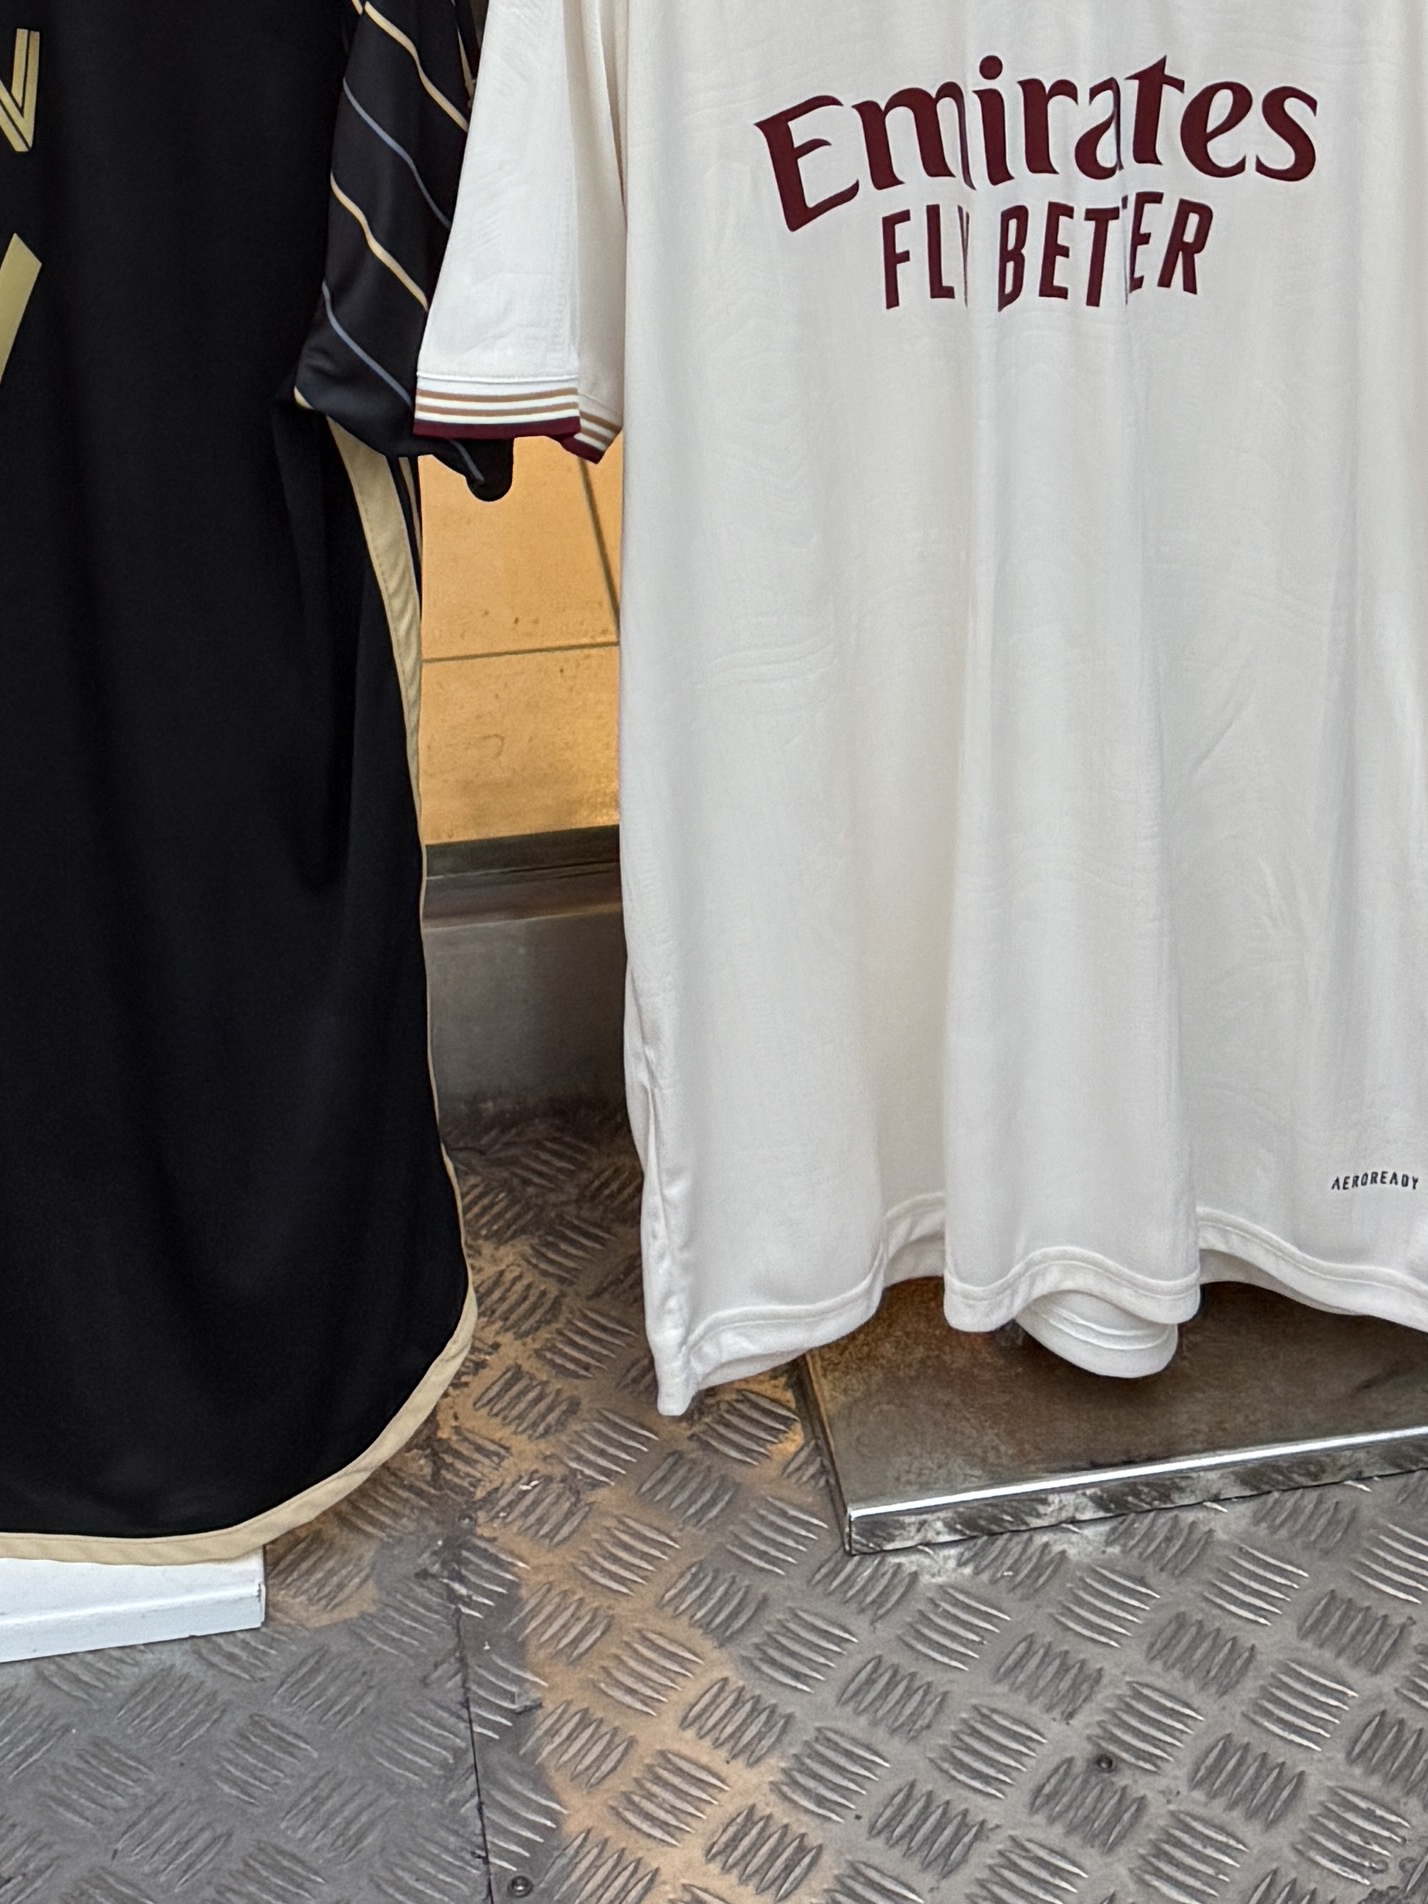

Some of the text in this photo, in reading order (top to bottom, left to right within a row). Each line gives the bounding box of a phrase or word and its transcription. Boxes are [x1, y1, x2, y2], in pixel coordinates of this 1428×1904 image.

[755, 54, 1318, 233] Emirates
[996, 190, 1214, 313] BETER
[1330, 1170, 1420, 1191] AEROREADY
